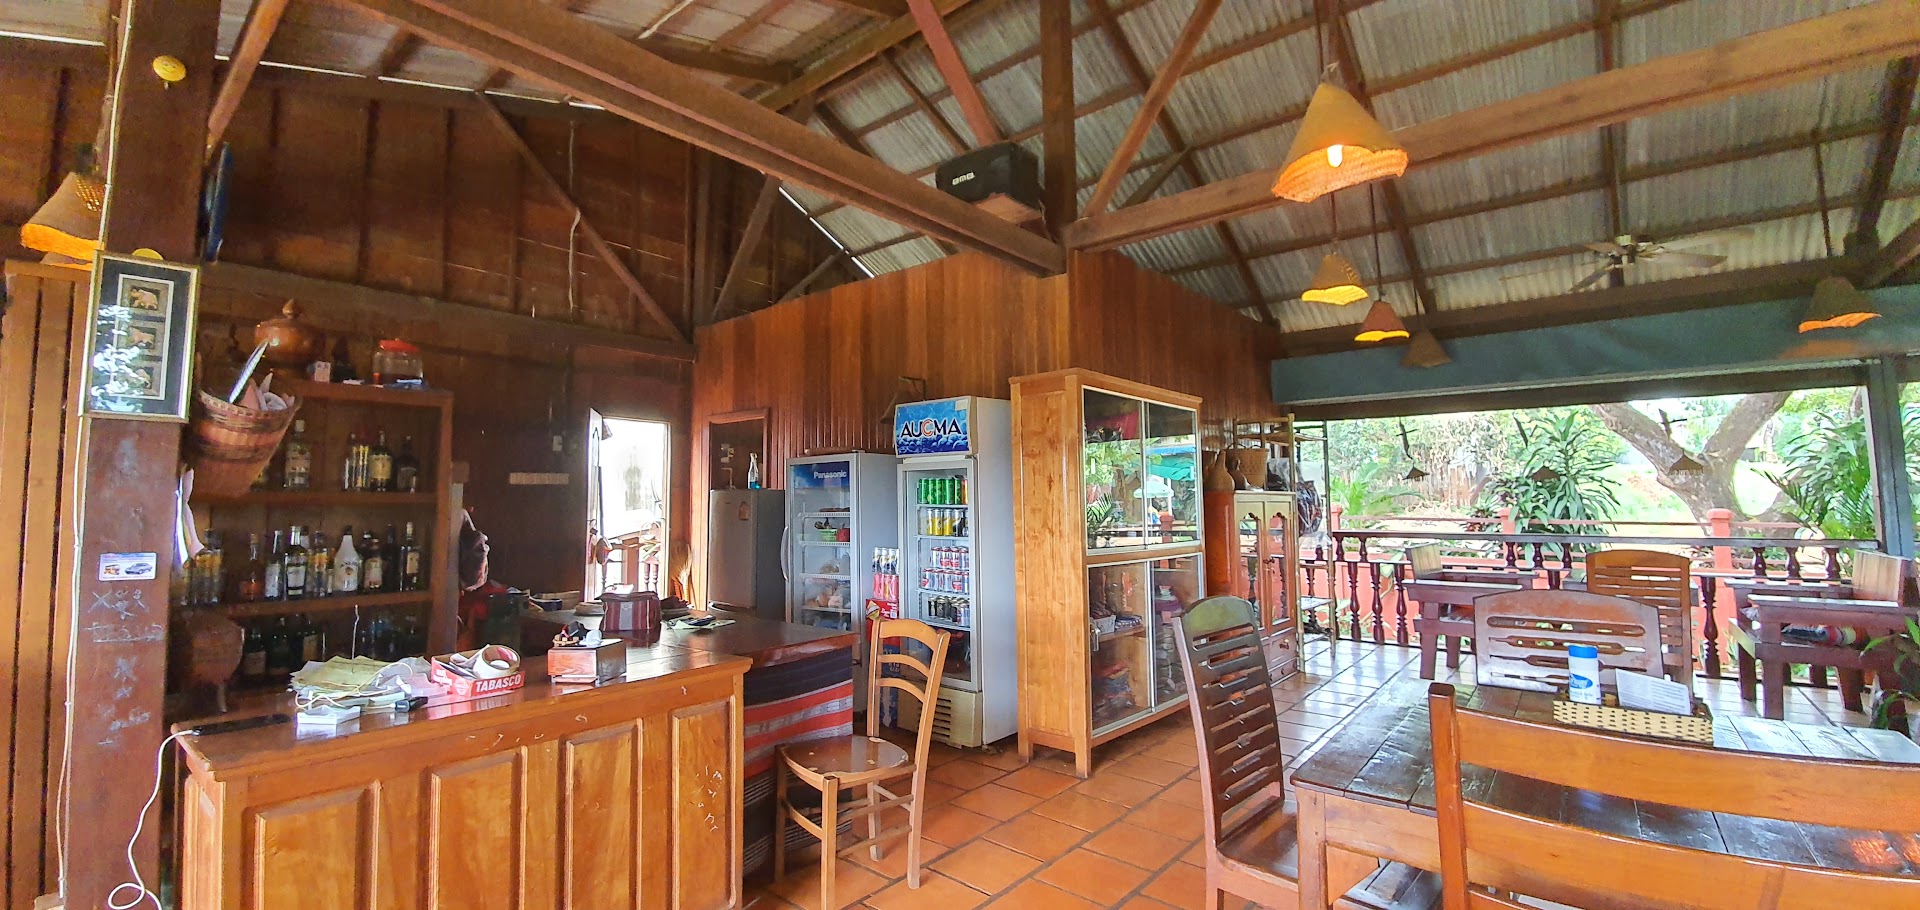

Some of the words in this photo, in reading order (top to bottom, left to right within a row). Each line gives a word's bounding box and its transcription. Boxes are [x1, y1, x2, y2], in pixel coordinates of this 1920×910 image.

[900, 418, 962, 438] AUCMA
[813, 470, 848, 479] Panasonic
[475, 674, 522, 693] TABASCO
